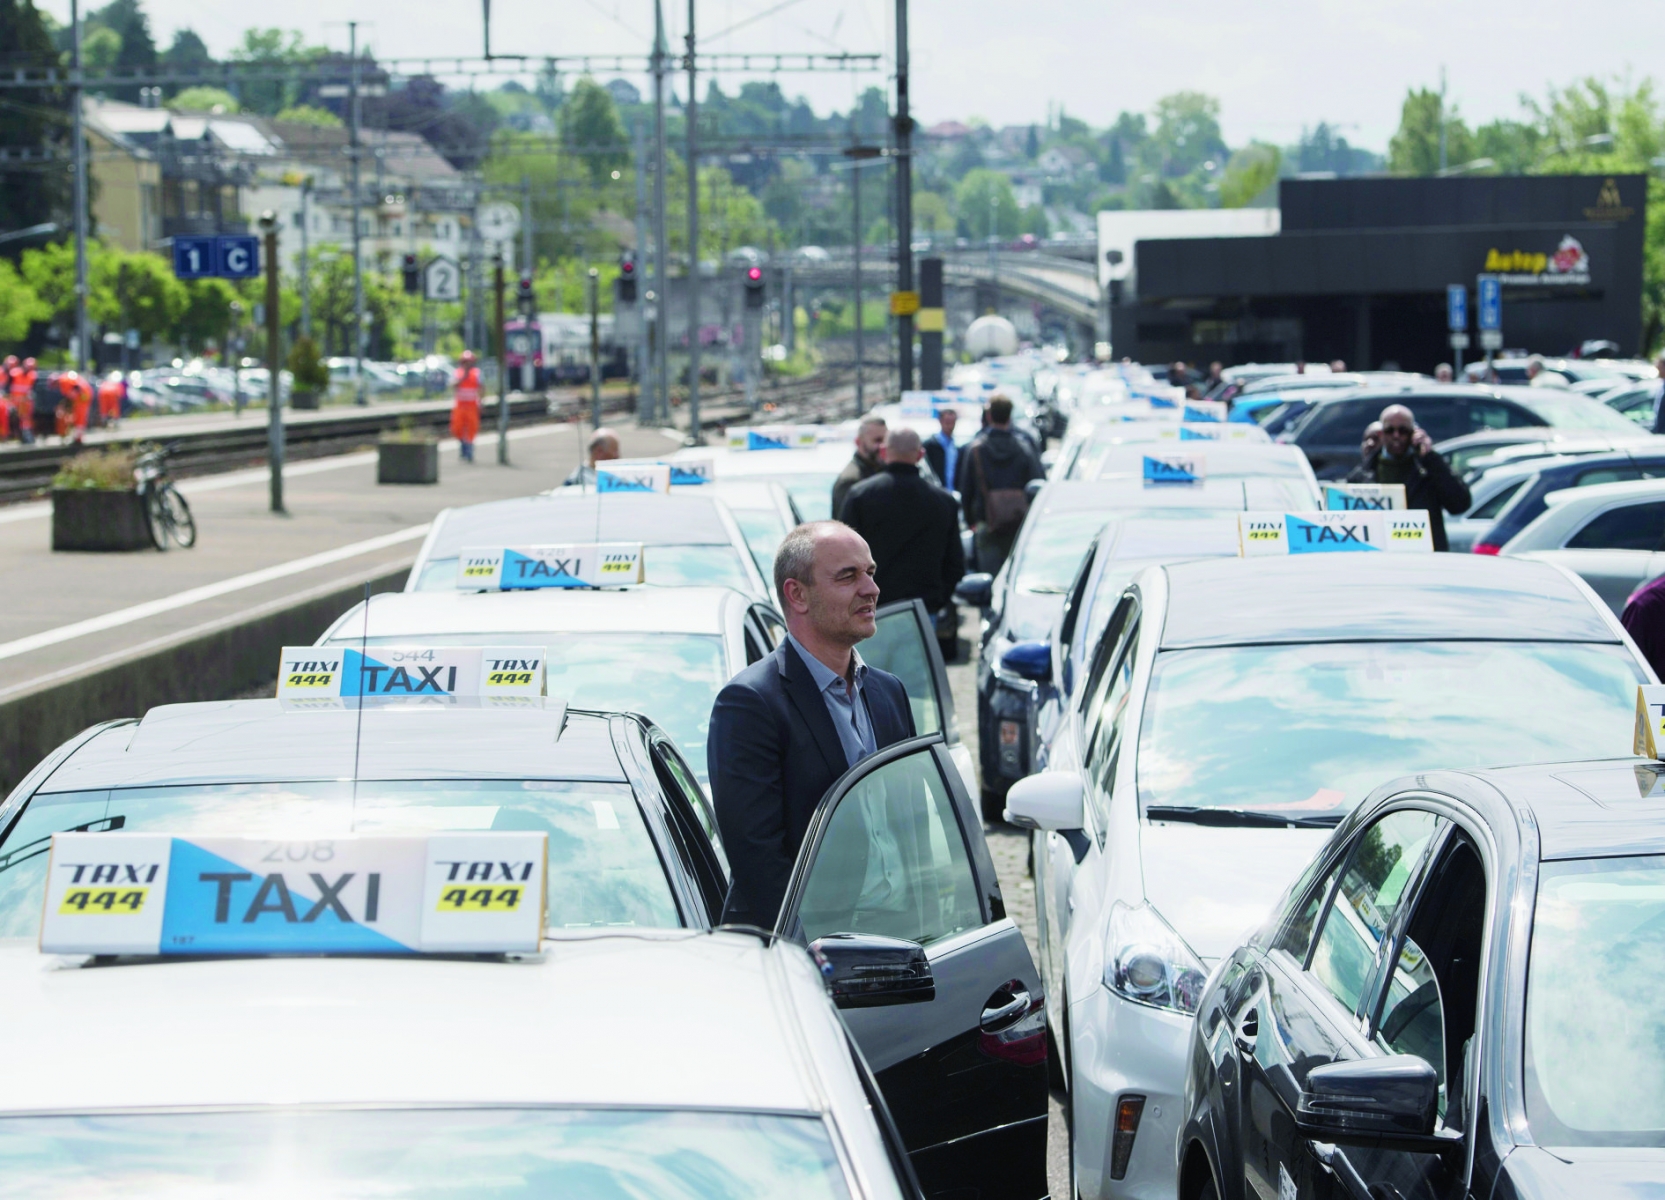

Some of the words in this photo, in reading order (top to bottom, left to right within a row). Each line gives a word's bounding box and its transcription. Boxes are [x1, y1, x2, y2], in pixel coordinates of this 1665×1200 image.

[187, 247, 201, 274] 1
[227, 247, 249, 273] C
[435, 266, 452, 293] 2
[1149, 460, 1196, 475] TAXI
[605, 476, 654, 489] TAXI
[1338, 496, 1393, 510] TAXI
[1297, 525, 1371, 543] TAXI
[514, 558, 582, 578] TAXI
[391, 648, 436, 662] 544
[485, 659, 540, 671] TAXI
[285, 660, 340, 673] TAXI
[288, 674, 332, 686] 444
[360, 665, 458, 693] TAXI
[489, 673, 533, 684] 444
[260, 840, 336, 863] 208
[58, 863, 160, 885] TAXI
[433, 860, 535, 883] TAXI
[63, 888, 146, 912] 444
[199, 871, 382, 924] TAXI
[441, 885, 523, 910] 444
